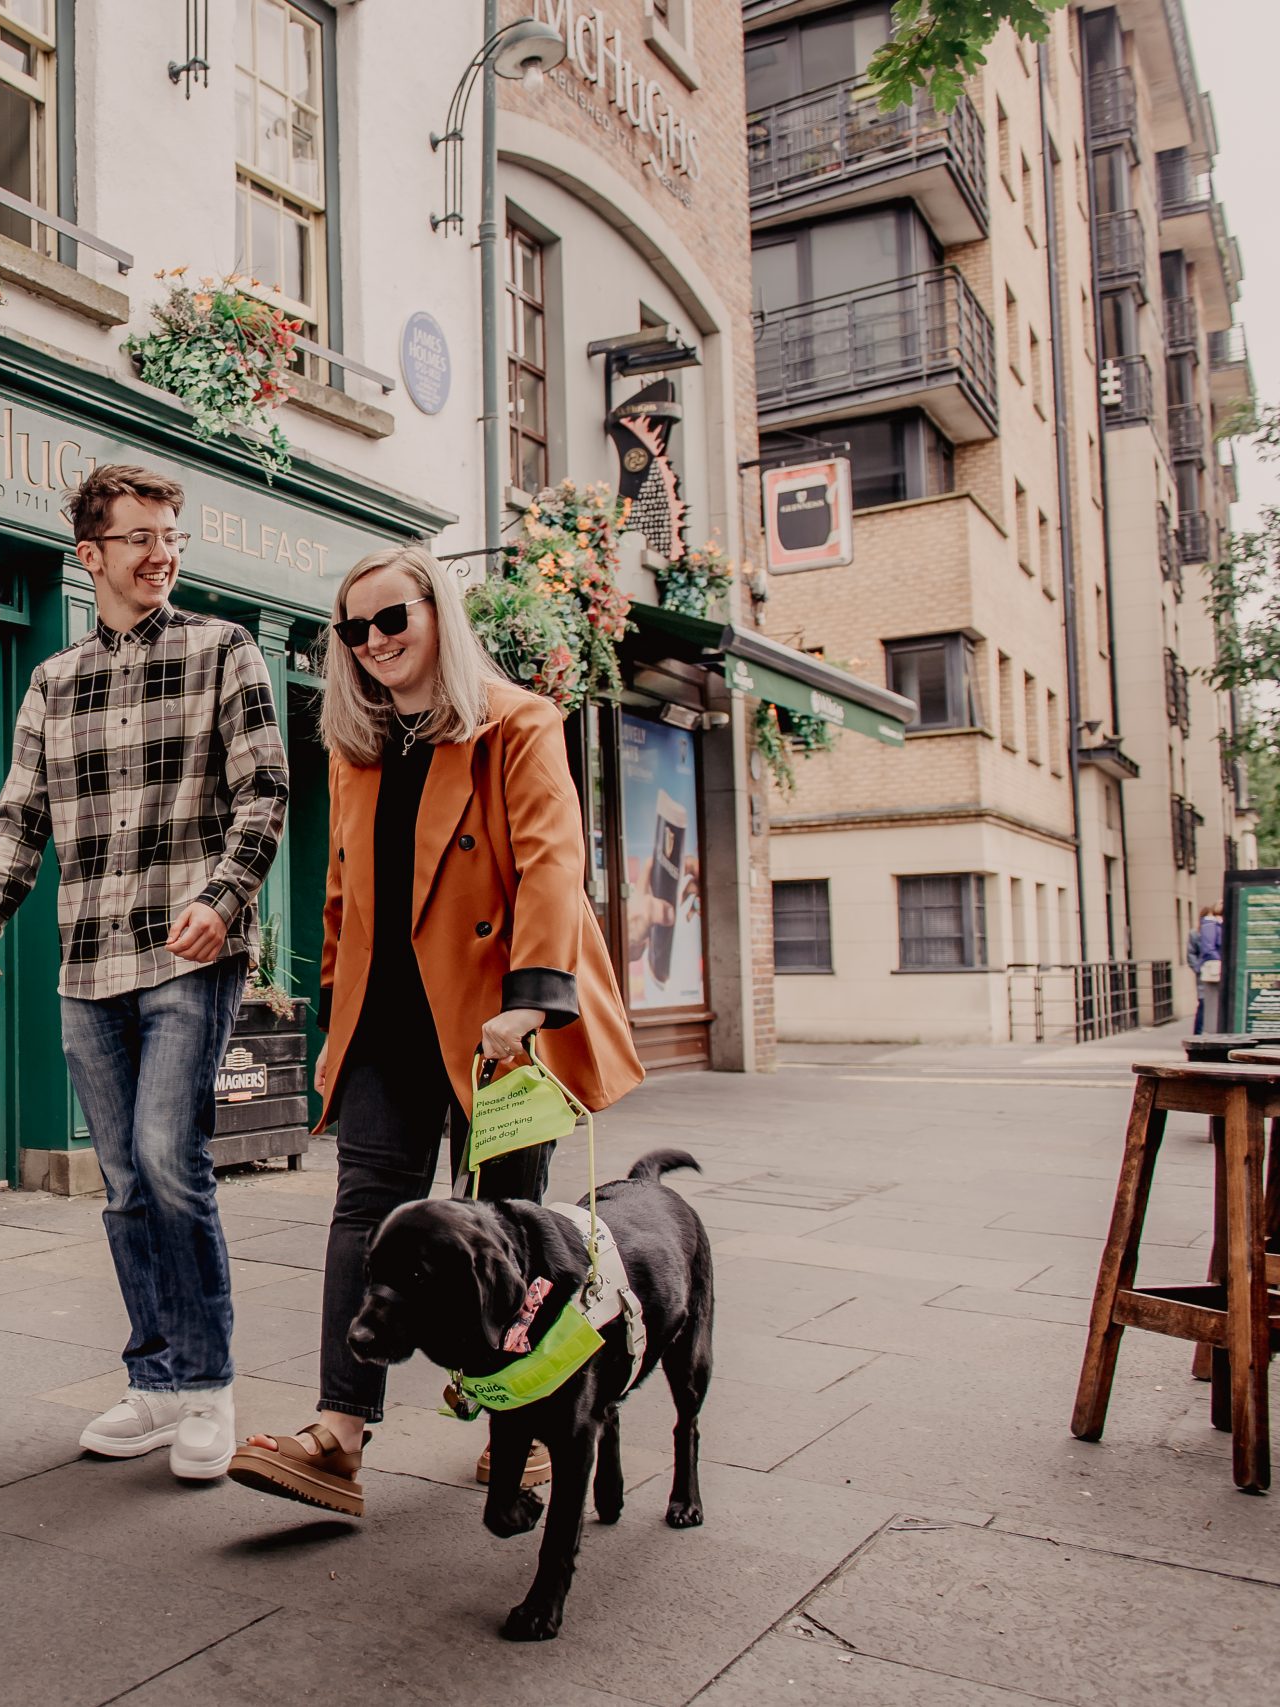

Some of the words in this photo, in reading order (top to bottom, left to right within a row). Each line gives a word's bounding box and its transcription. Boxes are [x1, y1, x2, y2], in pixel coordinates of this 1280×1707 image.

[14, 489, 50, 514] 1711
[201, 504, 329, 577] BELFAST
[214, 1069, 265, 1092] MAGNERS
[476, 1096, 505, 1108] Please
[508, 1086, 528, 1099] don't
[475, 1104, 509, 1117] distract
[475, 1128, 487, 1138] I'm
[497, 1116, 532, 1129] working
[474, 1134, 497, 1149] guide
[498, 1128, 518, 1138] dog!
[474, 1383, 506, 1393] Guid
